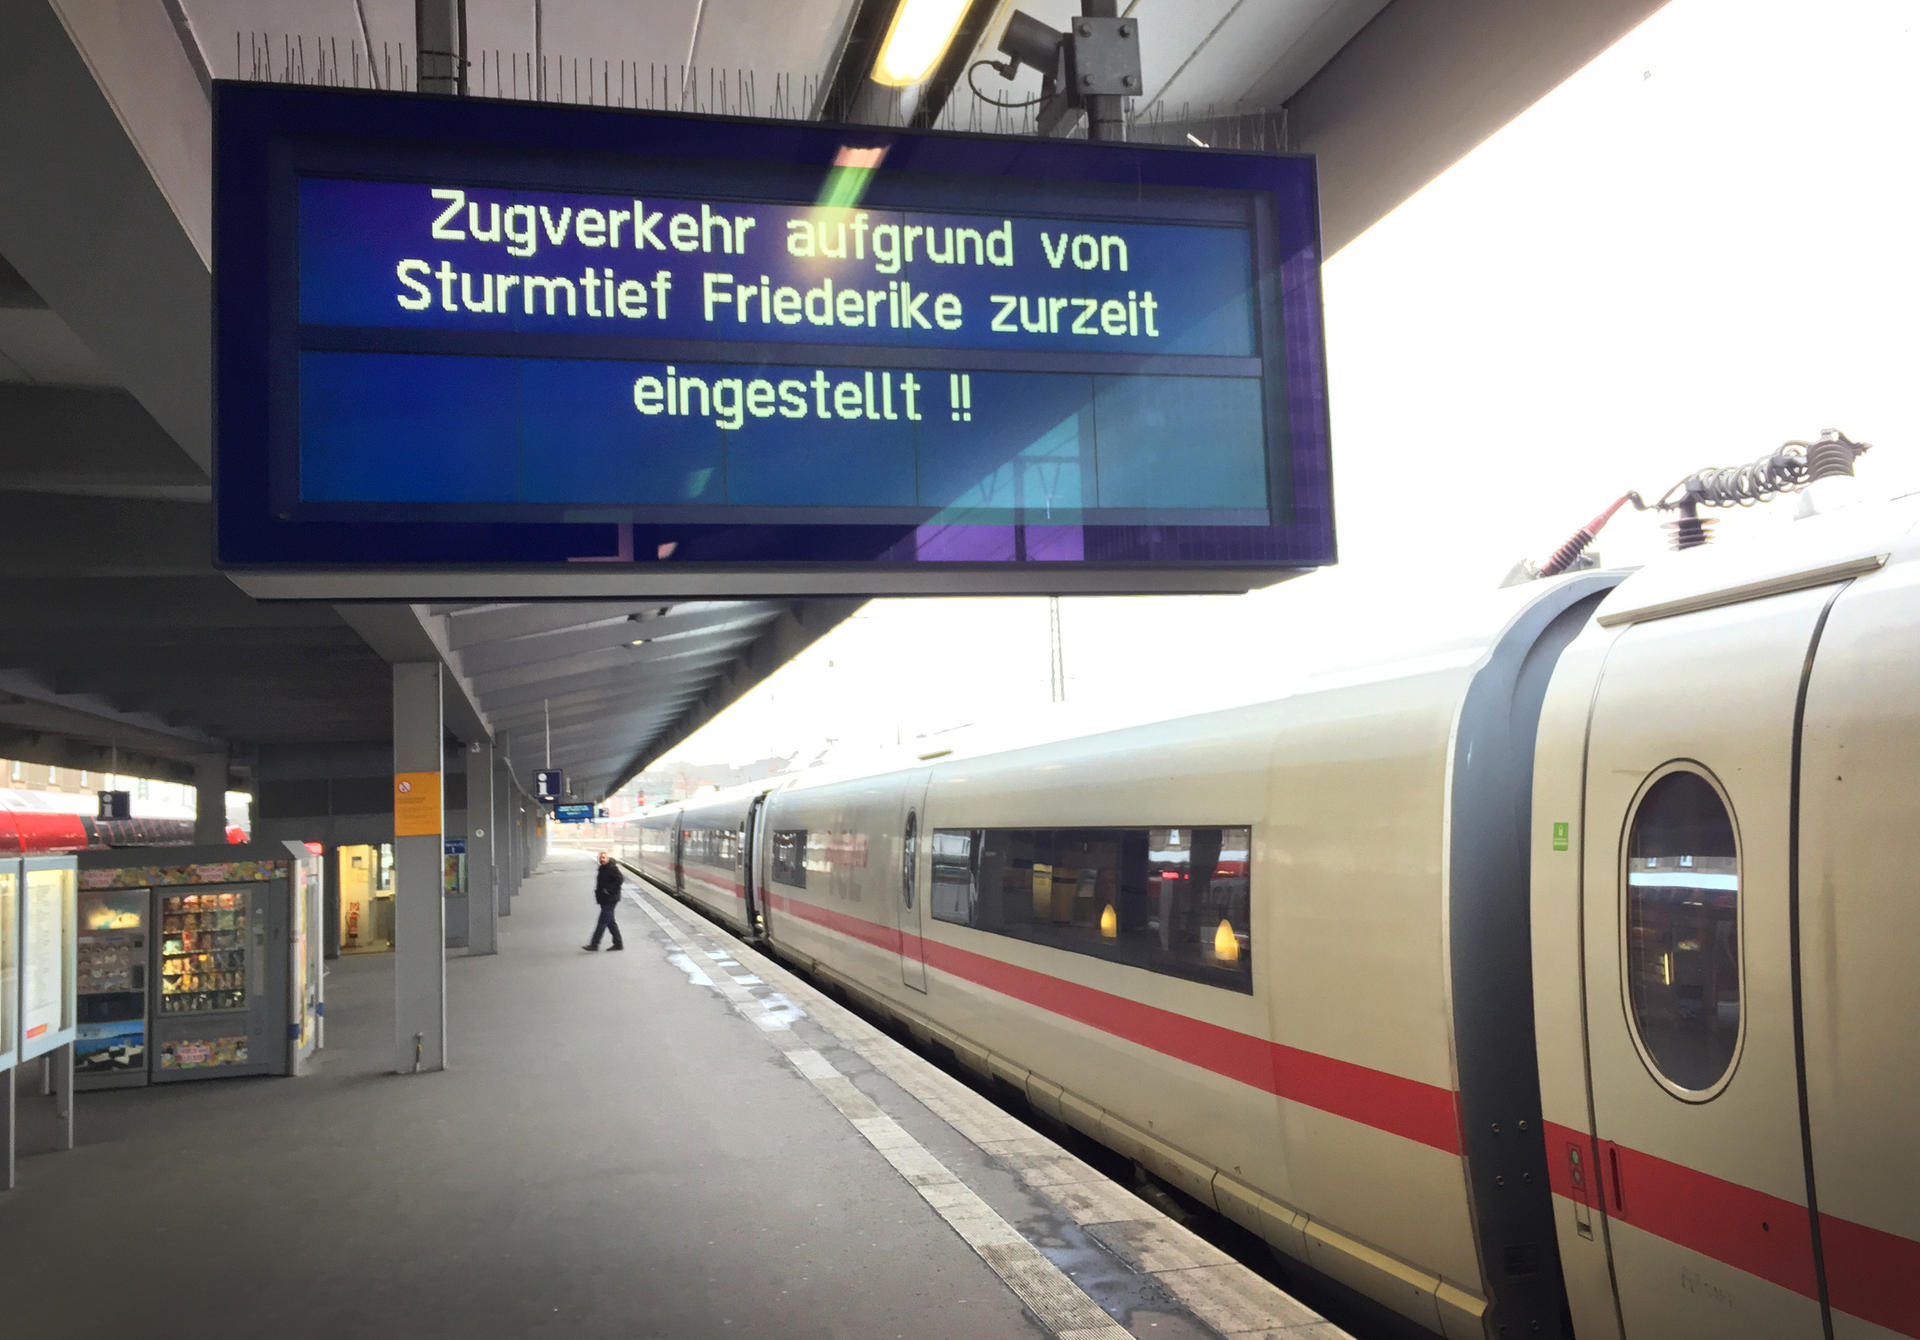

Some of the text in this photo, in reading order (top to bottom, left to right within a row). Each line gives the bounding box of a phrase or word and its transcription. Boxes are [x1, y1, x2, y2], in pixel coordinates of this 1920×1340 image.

[431, 188, 1128, 274] Zugverkehr aufgrund von
[396, 259, 1159, 337] Sturmtief Friederike zurzeit
[633, 365, 971, 430] eingestellt !!
